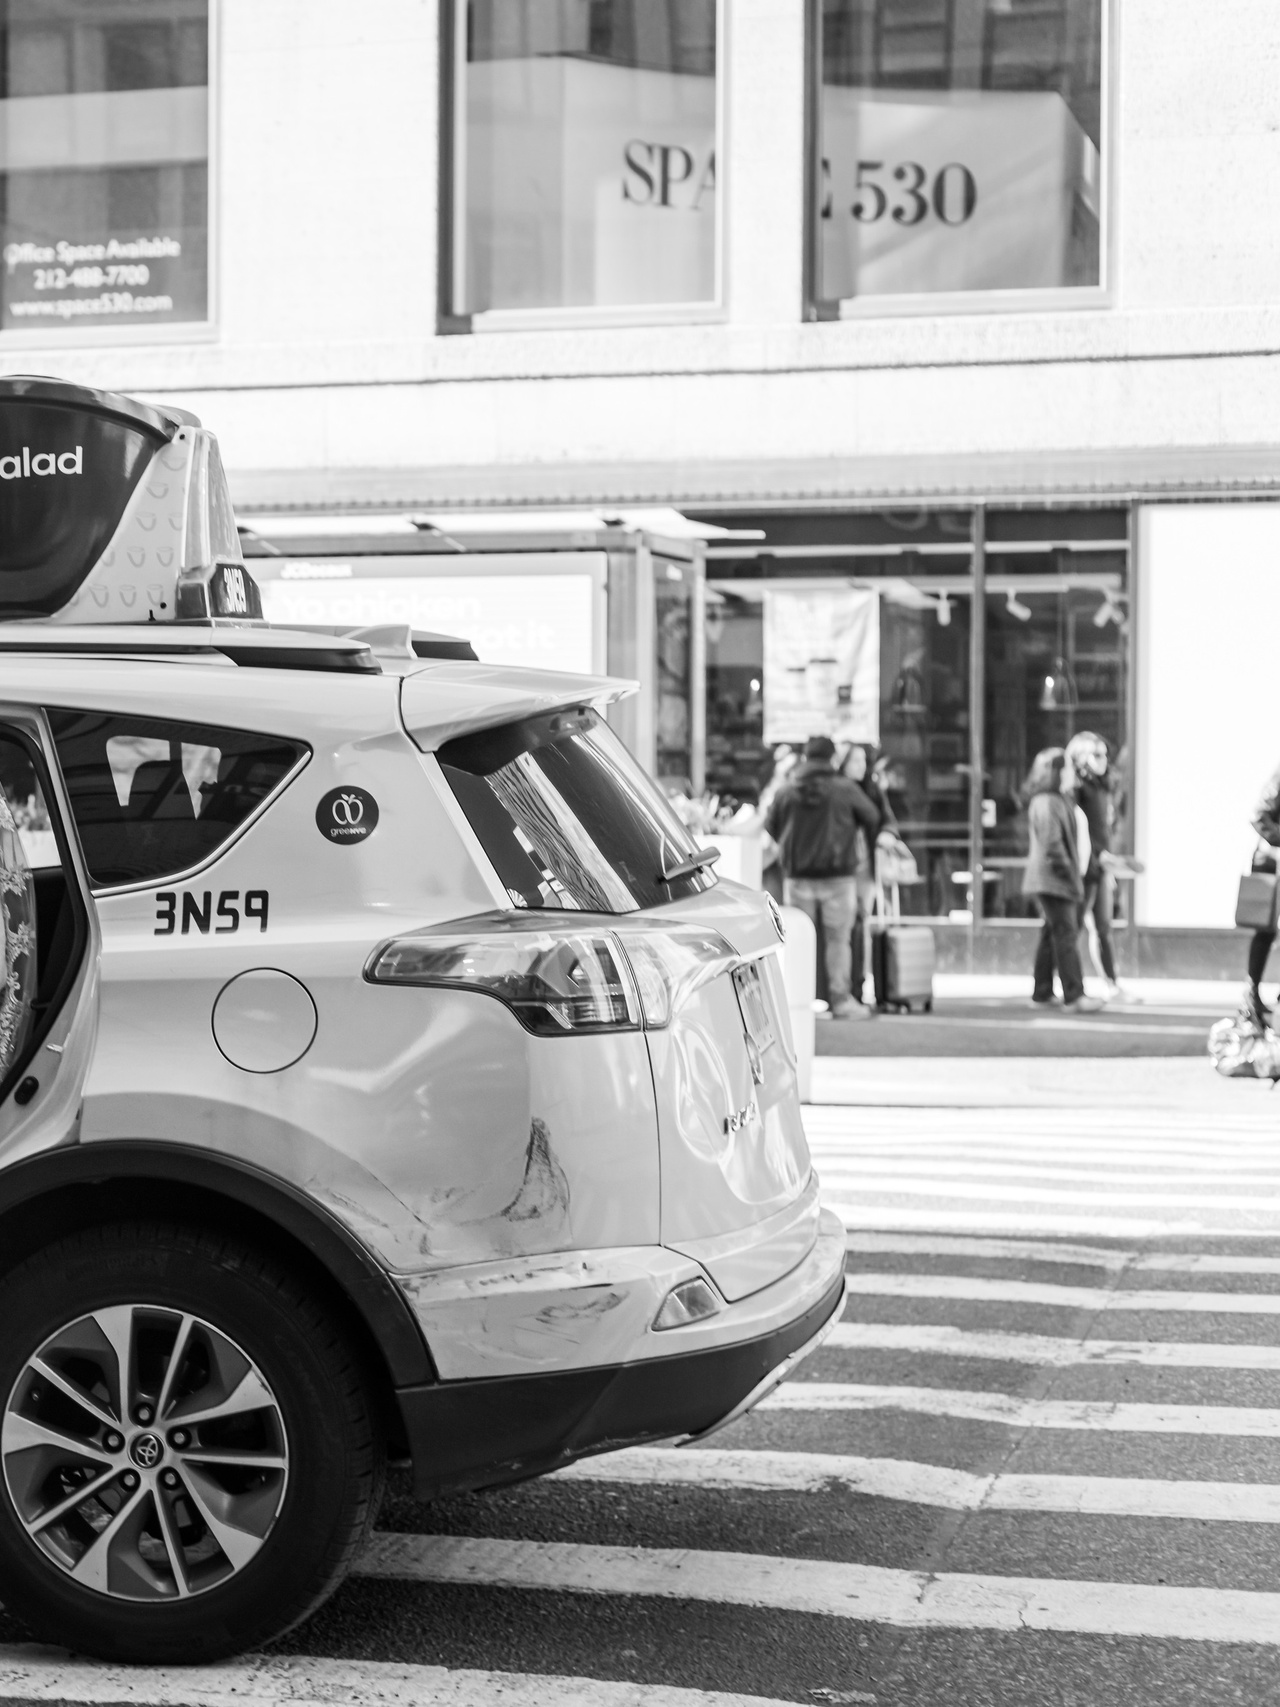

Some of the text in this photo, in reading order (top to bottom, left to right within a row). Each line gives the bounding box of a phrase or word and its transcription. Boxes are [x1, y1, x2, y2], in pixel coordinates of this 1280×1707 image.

[850, 159, 977, 226] 530
[3, 236, 181, 266] Office Space Available
[9, 292, 173, 320] www.space530.com
[154, 889, 270, 936] 3N59
